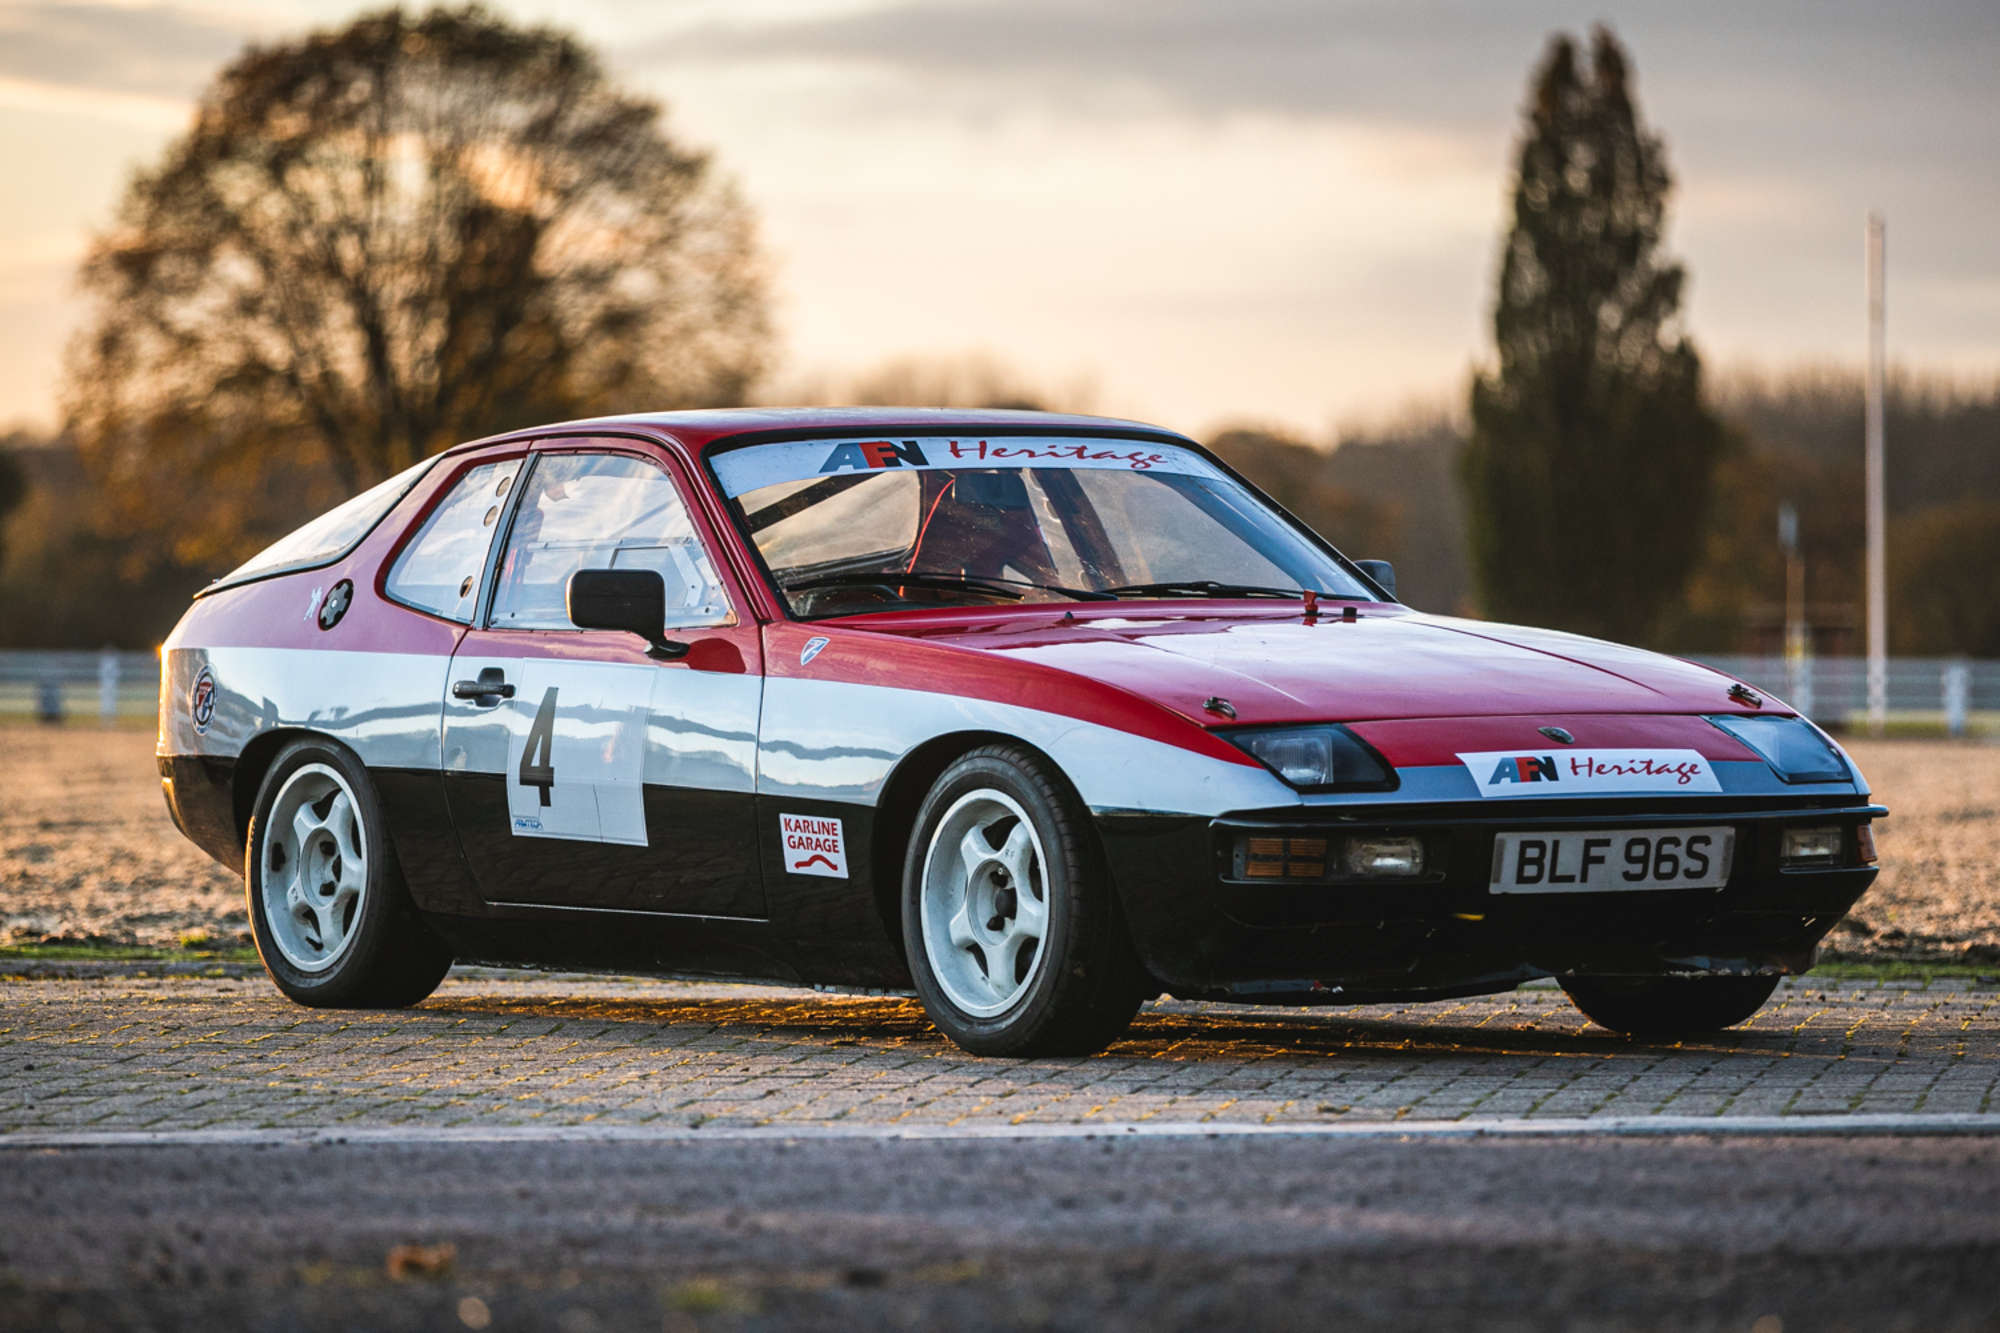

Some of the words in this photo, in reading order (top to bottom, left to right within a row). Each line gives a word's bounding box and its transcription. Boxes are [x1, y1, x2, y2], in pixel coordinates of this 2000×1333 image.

[818, 440, 930, 474] AFN
[950, 440, 1169, 469] Heritage
[519, 686, 560, 807] 4
[1488, 756, 1560, 785] AFN
[1570, 757, 1702, 785] Heritage
[784, 817, 839, 837] KARLINE
[787, 835, 840, 854] GARAGE
[1515, 838, 1612, 885] BLF
[1622, 835, 1712, 882] 96S
